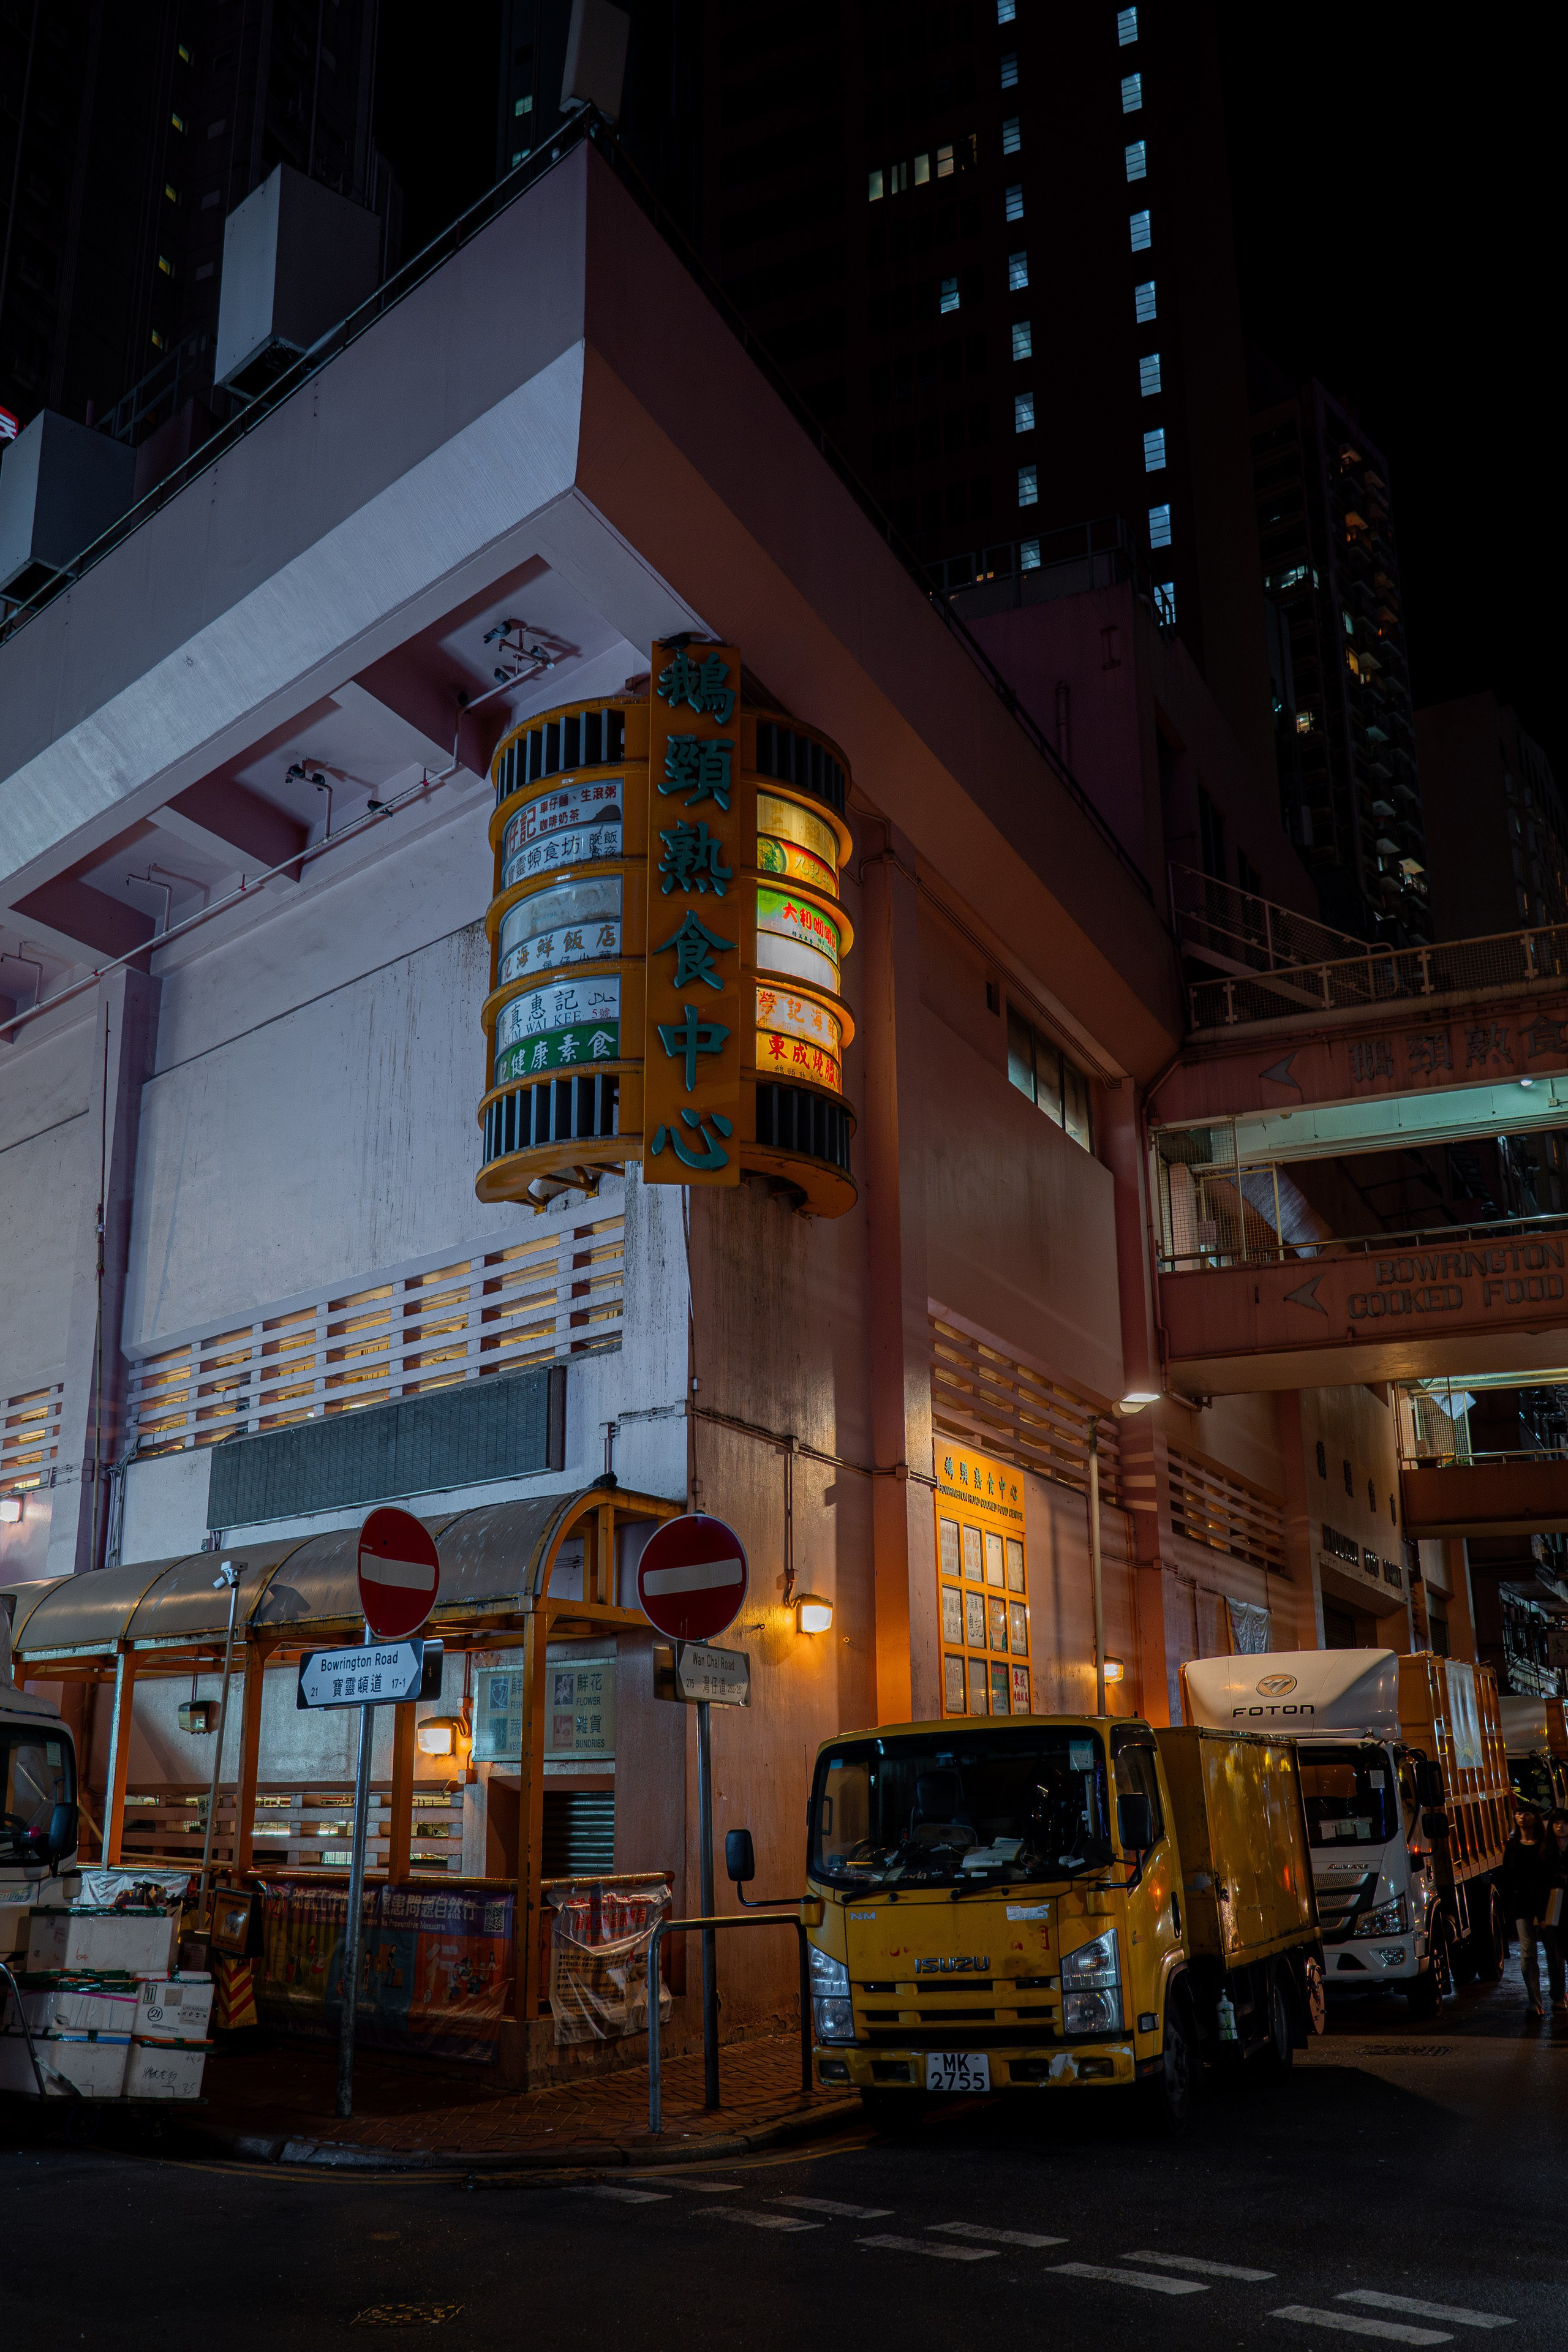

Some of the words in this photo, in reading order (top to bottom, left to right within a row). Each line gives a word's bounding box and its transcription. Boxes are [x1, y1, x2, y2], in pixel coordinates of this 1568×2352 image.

[540, 809, 579, 832] 咖啡奶茶
[506, 806, 537, 862] 仔記
[652, 650, 738, 1170] 鵝頸熟食中心
[526, 1017, 547, 1034] WAI
[554, 1010, 582, 1027] KEE
[1349, 1016, 1568, 1082] 鵝頸熟食
[768, 1035, 839, 1090] 東成燒臘
[1376, 1242, 1566, 1285] BOWRINGTON
[1348, 1285, 1463, 1319] COOKED
[1483, 1275, 1564, 1306] FOOD
[944, 1456, 1019, 1502] 鵝頸熟食中心
[938, 1484, 968, 1502] BOWRINGTON
[968, 1494, 980, 1506] ROAD
[980, 1498, 997, 1512] COOKED
[997, 1504, 1009, 1517] FOOD
[1008, 1507, 1024, 1521] CENTRE
[321, 1655, 371, 1672] Bowrington
[375, 1651, 398, 1666] Road
[692, 1651, 704, 1666] Wan
[706, 1654, 720, 1668] Chai
[721, 1656, 735, 1671] Road
[311, 1687, 318, 1697] 21
[333, 1673, 382, 1698] 寶靈頓道
[577, 1672, 603, 1692] 鮮花
[686, 1678, 695, 1689] 275
[703, 1675, 726, 1695] 灣仔道
[576, 1696, 601, 1706] FLOWER
[1232, 1704, 1314, 1717] FOTON
[576, 1714, 602, 1735] 雜貨
[575, 1738, 605, 1749] SUNDRIES
[915, 1956, 989, 1973] ISUZU
[148, 2009, 160, 2019] 21
[943, 2054, 970, 2071] MK
[931, 2071, 985, 2090] 2755
